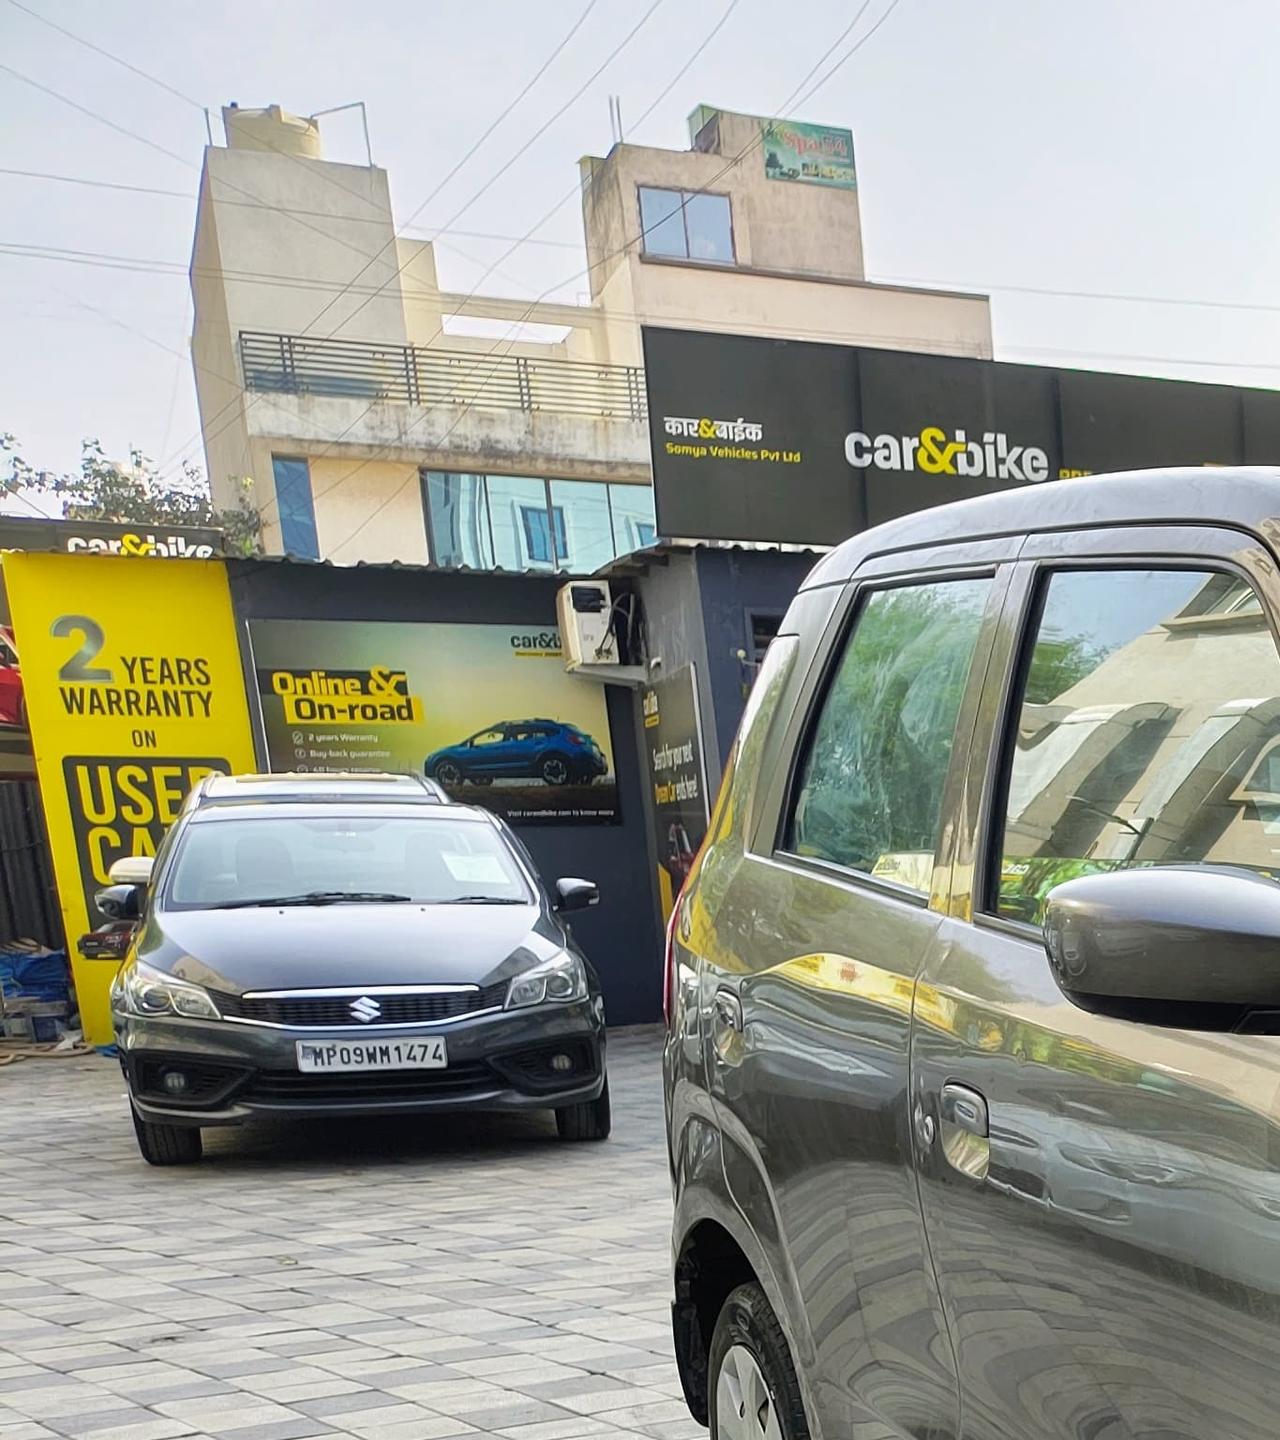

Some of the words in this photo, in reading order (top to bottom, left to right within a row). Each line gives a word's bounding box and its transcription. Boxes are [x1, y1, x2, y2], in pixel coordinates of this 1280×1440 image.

[665, 442, 707, 458] Somya
[710, 446, 758, 461] Vehicles
[760, 449, 780, 462] Pvt
[783, 451, 801, 463] Ltd
[844, 426, 1050, 482] car&bike
[51, 614, 113, 682] 2
[120, 656, 212, 686] YEARS
[272, 671, 361, 696] Online
[59, 687, 213, 718] WARRANTY
[294, 697, 413, 721] On-road
[131, 729, 157, 748] ON
[312, 1043, 443, 1067] MP09WM1474
